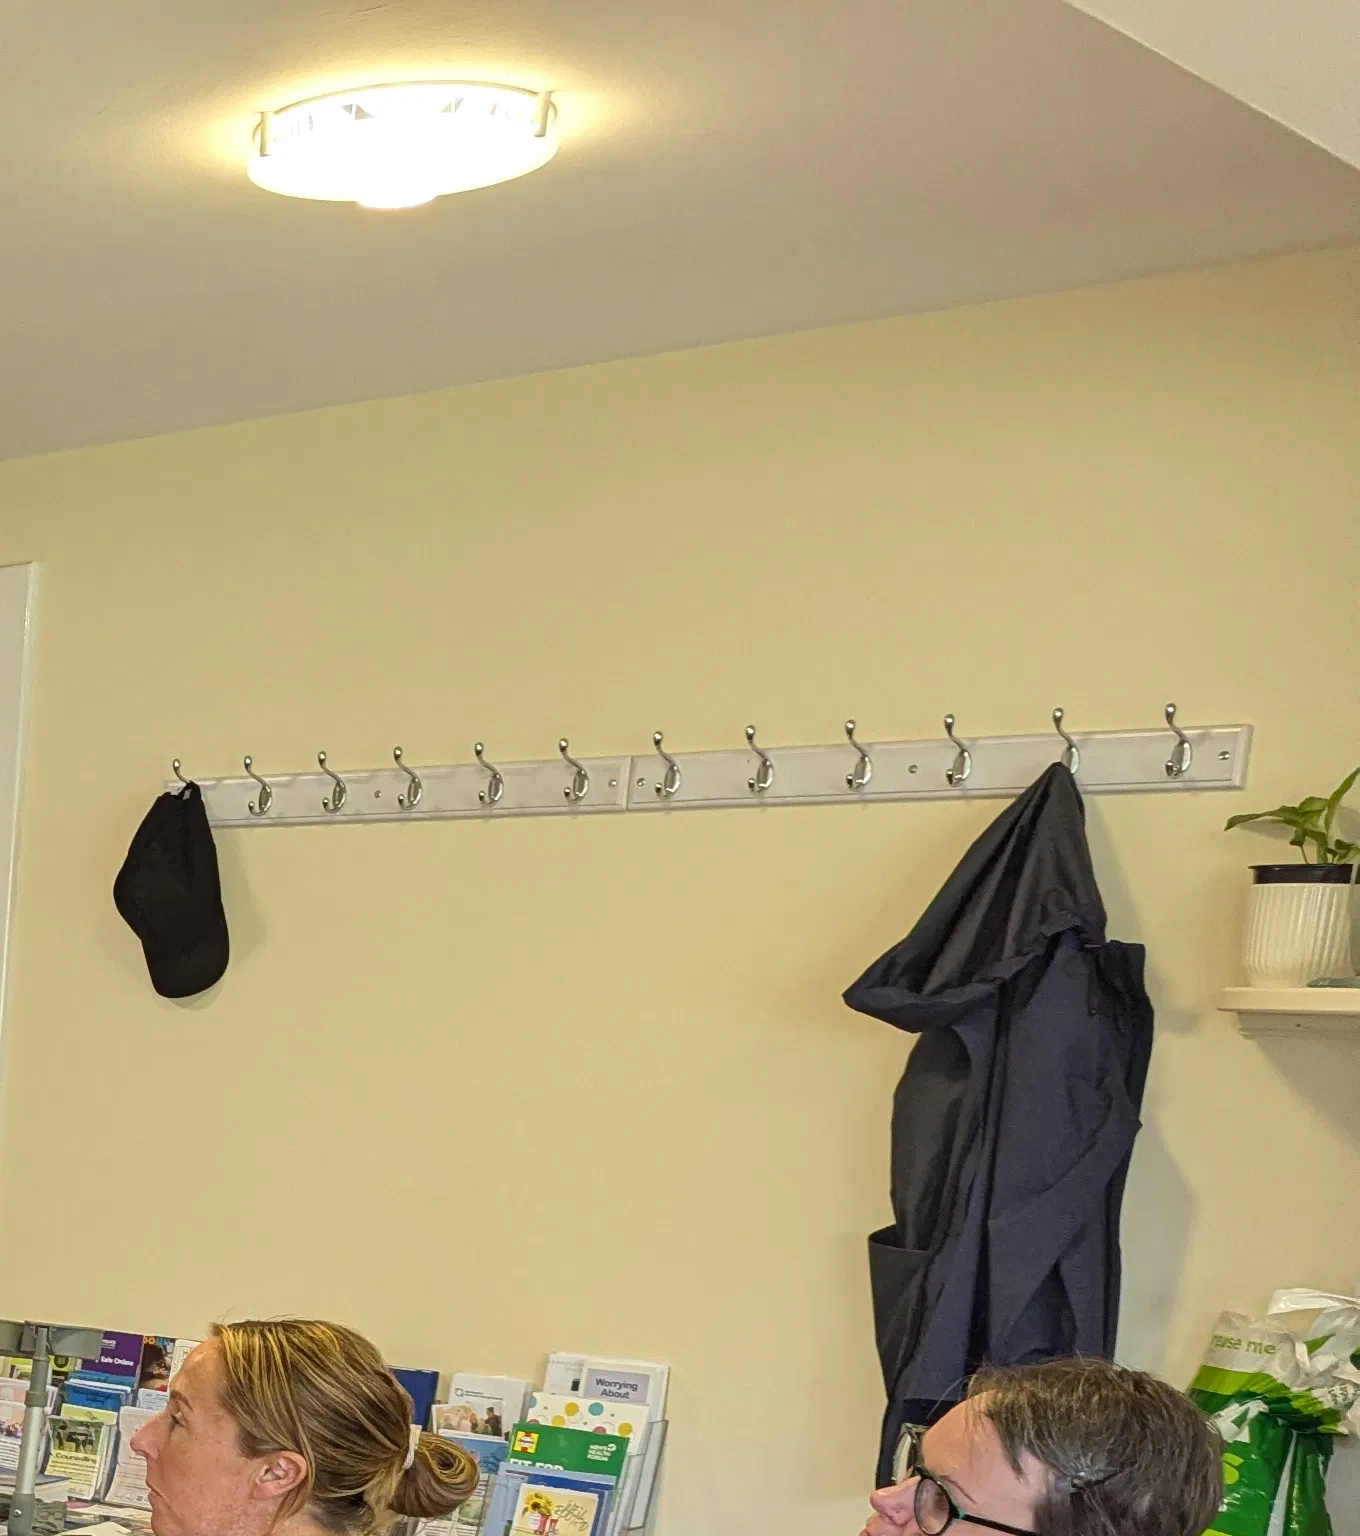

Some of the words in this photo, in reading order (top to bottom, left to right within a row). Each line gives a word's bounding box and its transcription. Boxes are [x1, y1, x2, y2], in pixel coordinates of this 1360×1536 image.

[1247, 1341, 1276, 1354] me
[596, 1378, 638, 1391] Worrying
[601, 1389, 629, 1399] About
